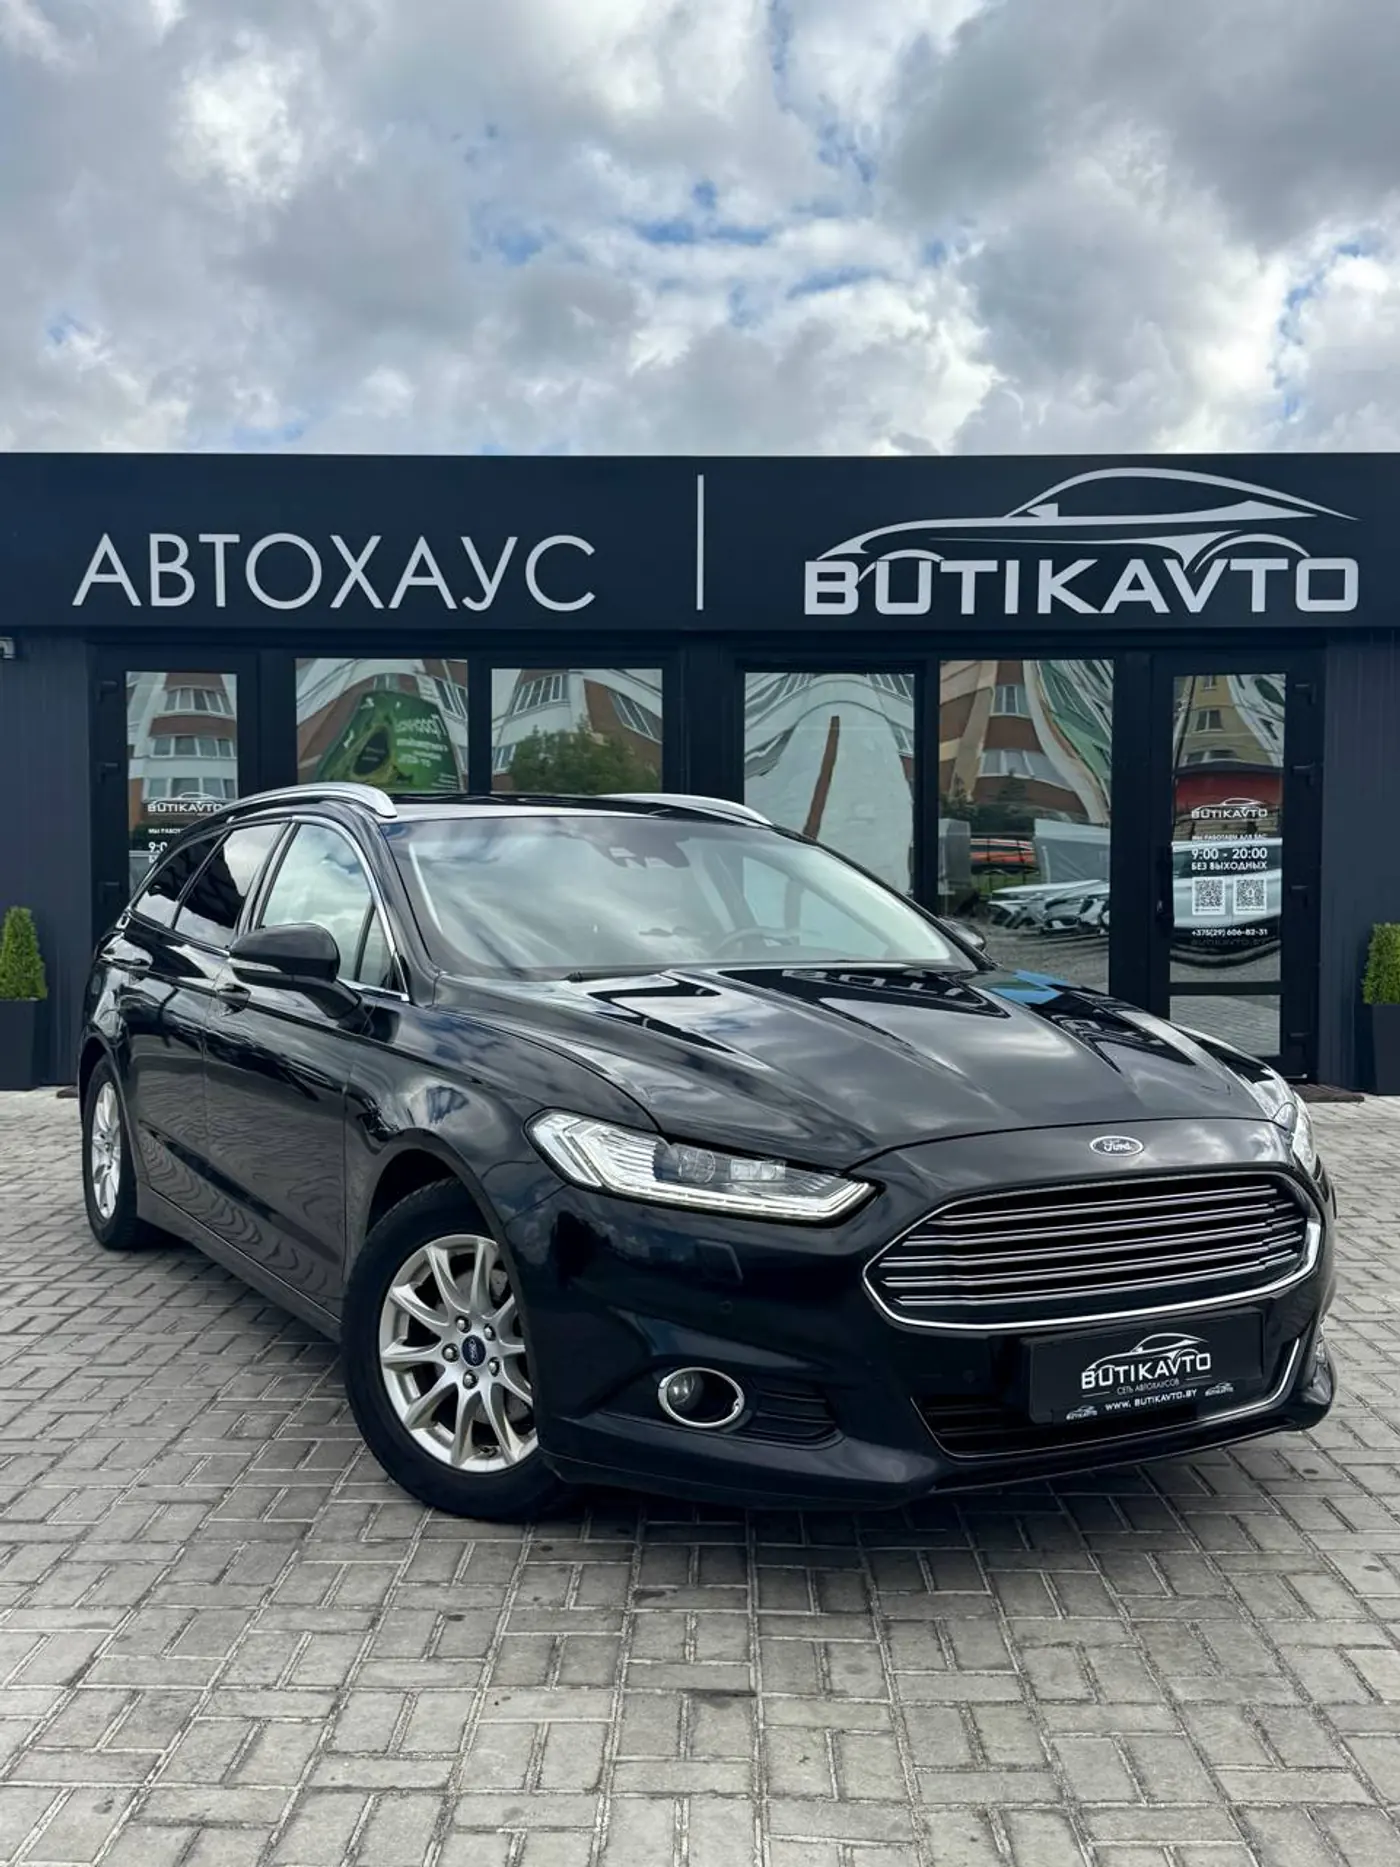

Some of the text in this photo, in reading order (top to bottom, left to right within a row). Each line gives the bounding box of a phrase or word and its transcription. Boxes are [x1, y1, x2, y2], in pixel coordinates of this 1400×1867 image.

[72, 532, 596, 611] АВТОХАУС
[804, 556, 1359, 615] BUTIKAVTO
[1191, 808, 1268, 819] BUTIKAVTO
[1191, 848, 1219, 860] 9:00
[1232, 847, 1268, 860] 20:00
[1191, 861, 1268, 871] БЕЗ ВЫХОДНЫХ
[1095, 1138, 1136, 1152] Ford
[1081, 1353, 1212, 1390] BUTIKAVTO
[1117, 1385, 1134, 1396] СЕТЬ
[1134, 1388, 1197, 1407] BUTIKAVTO.BY
